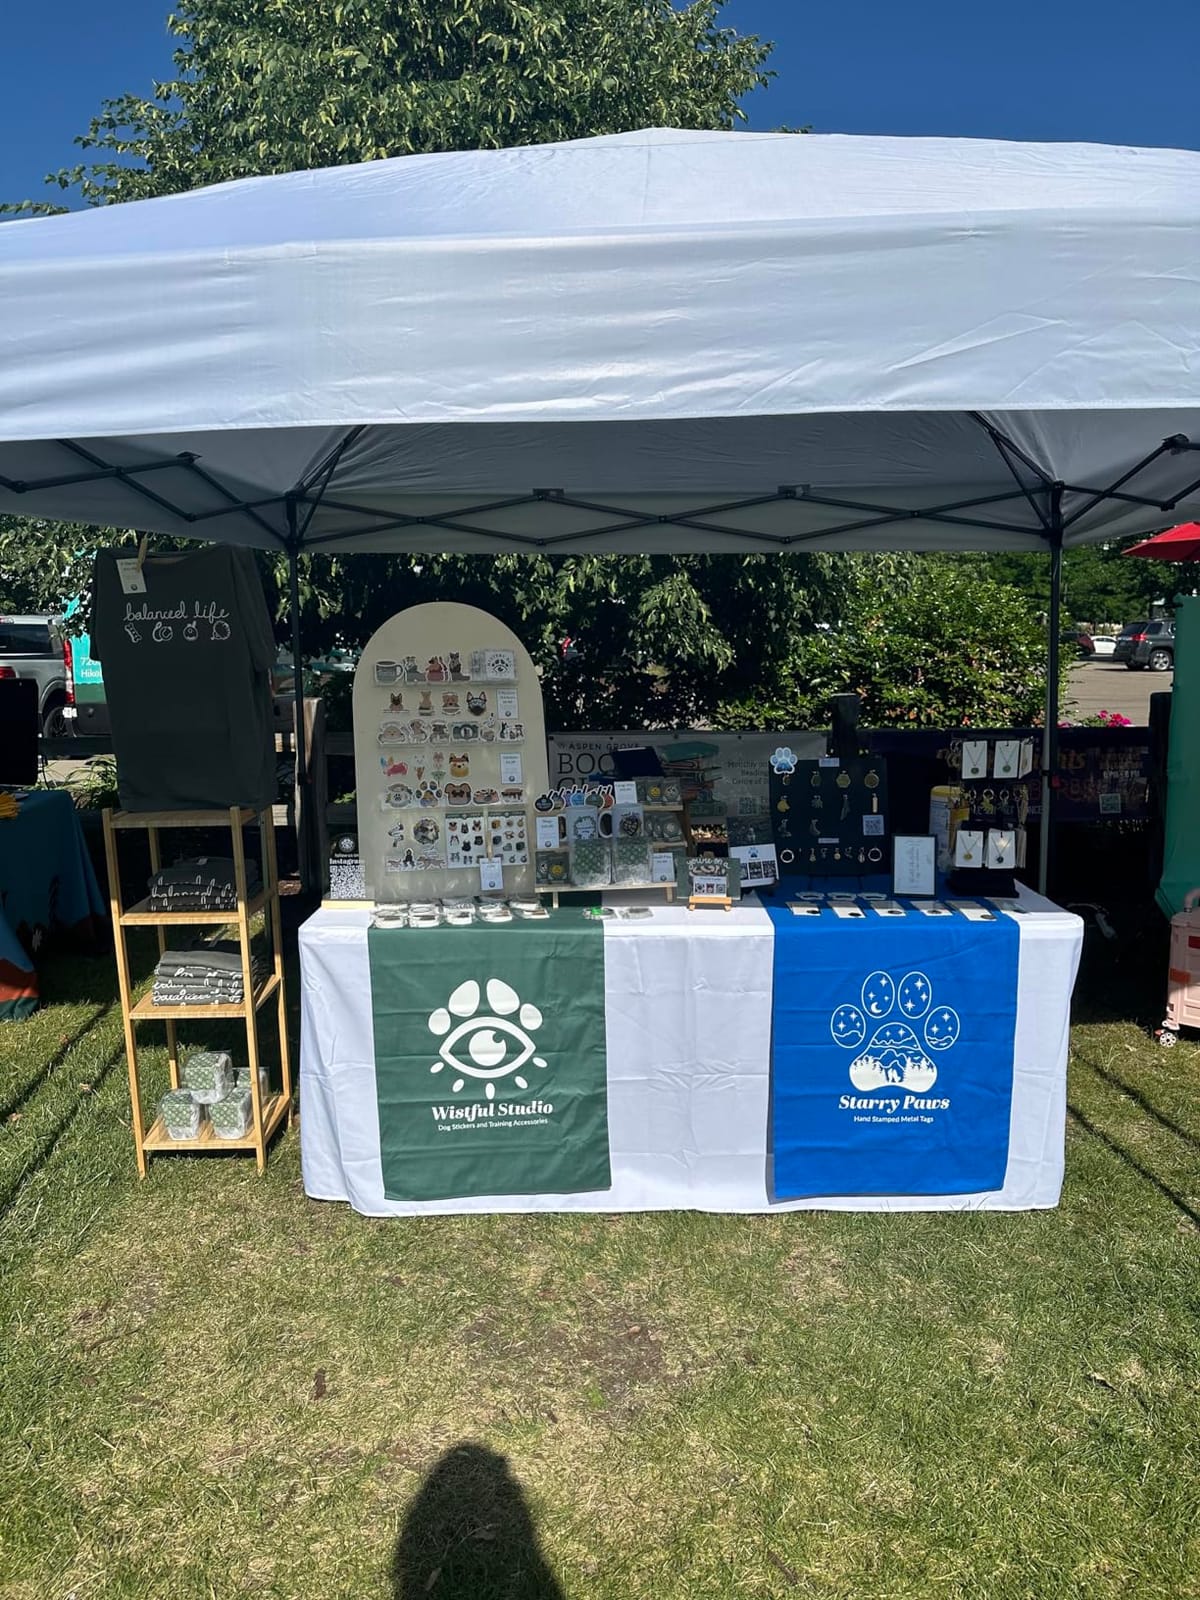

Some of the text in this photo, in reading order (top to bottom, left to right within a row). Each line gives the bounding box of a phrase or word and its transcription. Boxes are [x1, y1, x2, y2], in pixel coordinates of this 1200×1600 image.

[123, 600, 230, 624] balanced life
[432, 1100, 553, 1122] Wistful Studio
[838, 1095, 950, 1114] Starry Paws
[438, 1124, 451, 1132] Dog
[452, 1122, 475, 1130] Stickers
[489, 1119, 512, 1128] Training
[513, 1118, 548, 1126] Accessories
[872, 1115, 900, 1124] Stamped
[920, 1115, 934, 1124] Tags
